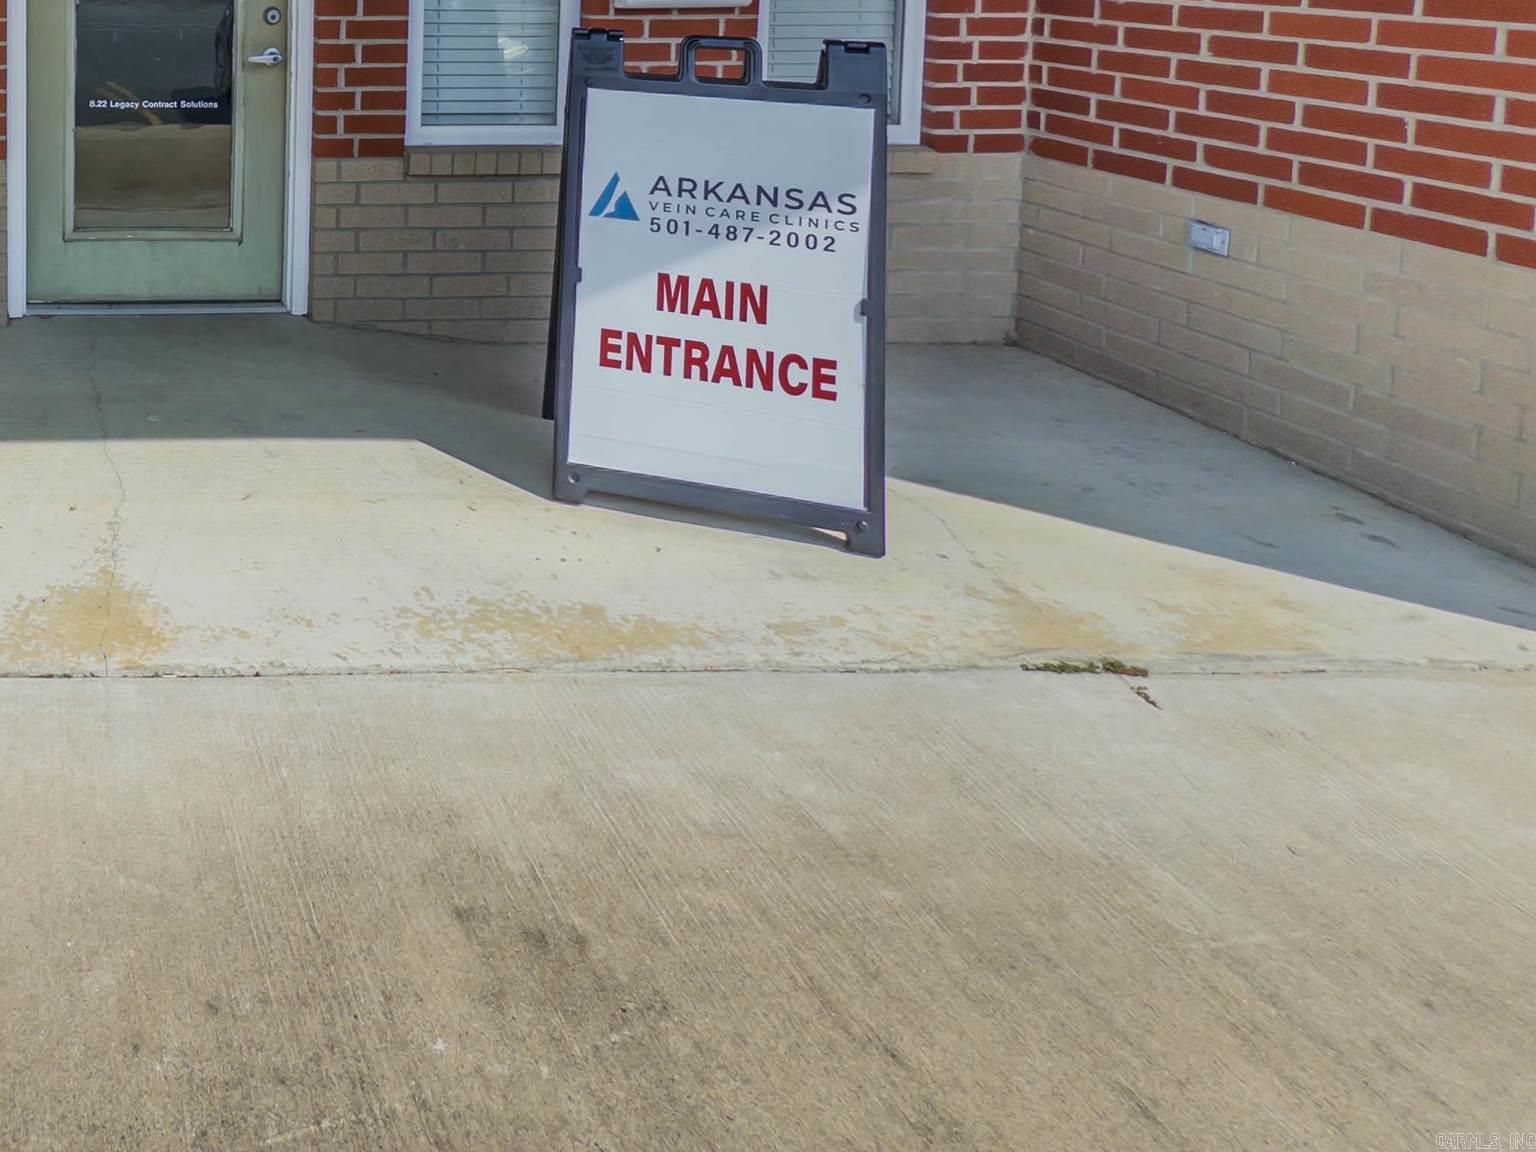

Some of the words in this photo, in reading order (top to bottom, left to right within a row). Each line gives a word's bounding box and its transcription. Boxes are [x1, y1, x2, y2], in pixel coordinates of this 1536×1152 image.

[89, 100, 108, 108] 8.22
[110, 100, 139, 110] Legacy
[142, 100, 178, 109] Contract
[180, 100, 218, 109] Solutions
[648, 175, 858, 216] ARKANSAS
[648, 200, 697, 215] VEIN
[705, 206, 760, 222] CARE
[768, 213, 860, 233] CLINICS
[648, 216, 837, 253] 501-487-2002
[655, 272, 768, 325] MAIN
[598, 327, 838, 402] ENTRANCE
